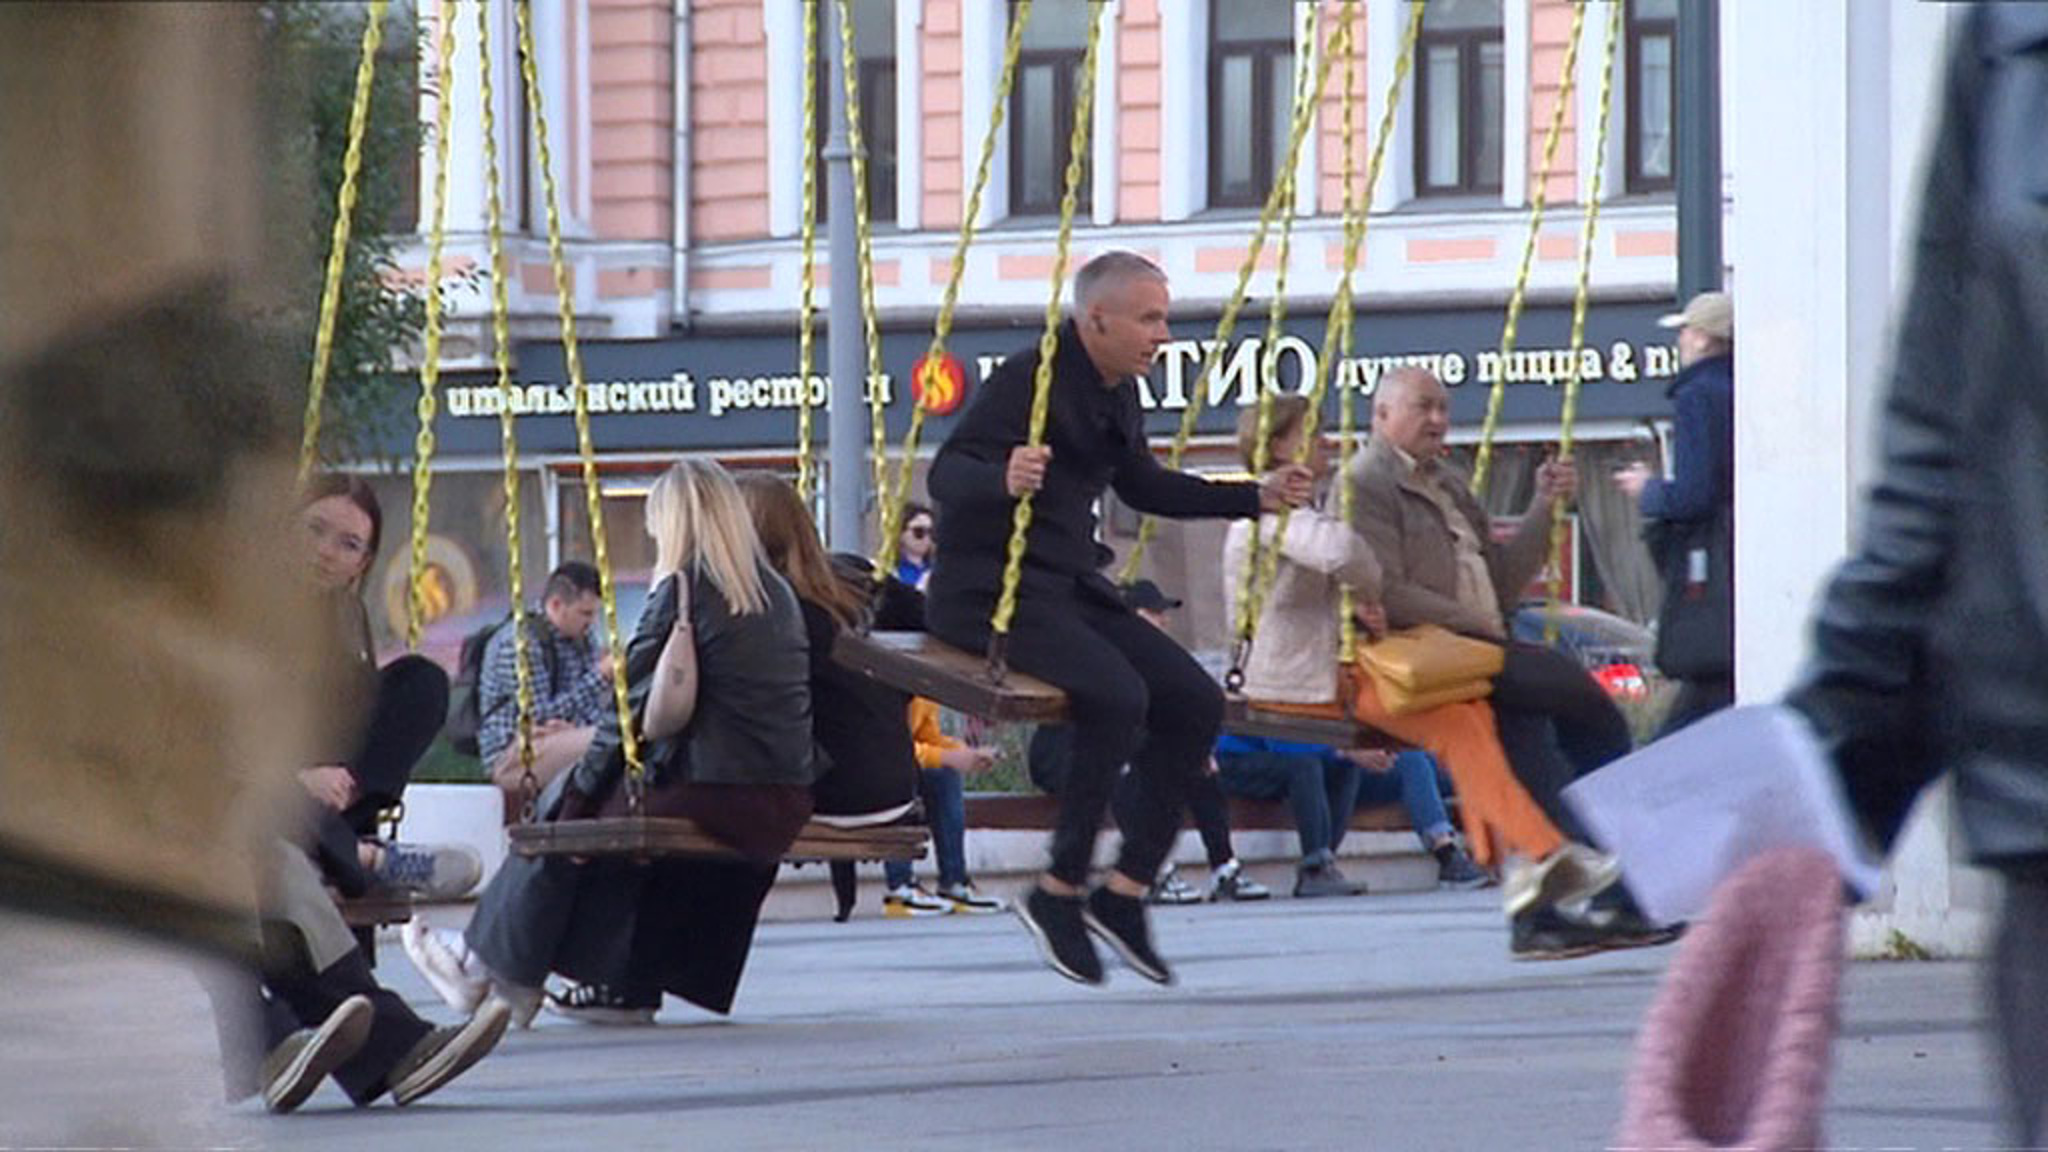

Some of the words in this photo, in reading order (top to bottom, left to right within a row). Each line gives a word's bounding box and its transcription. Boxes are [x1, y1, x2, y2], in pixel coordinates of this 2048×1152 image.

[1476, 348, 1603, 385] пицца
[1609, 341, 1636, 381] &
[710, 375, 892, 415] рестон
